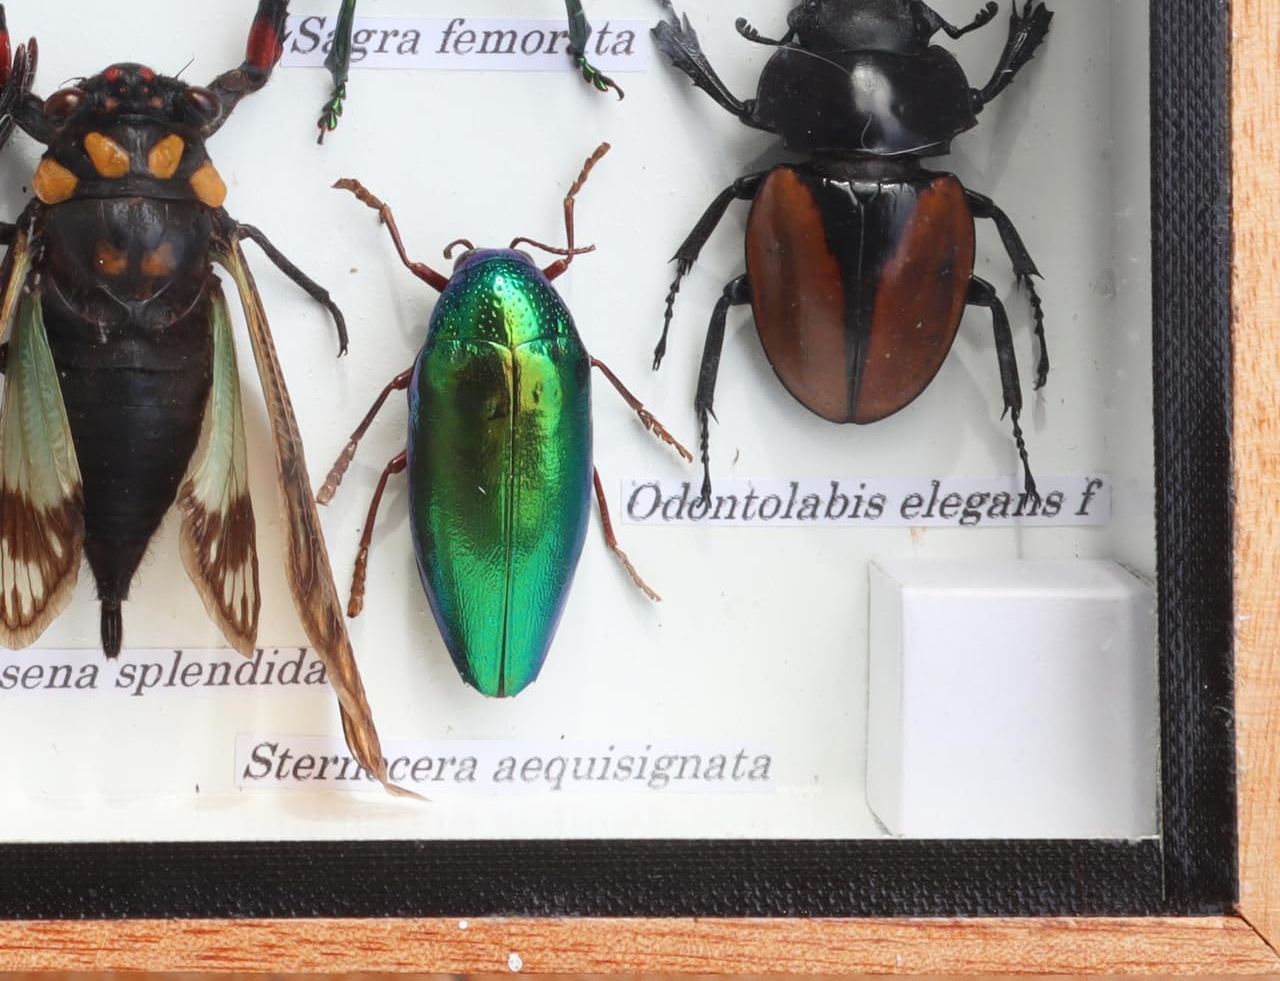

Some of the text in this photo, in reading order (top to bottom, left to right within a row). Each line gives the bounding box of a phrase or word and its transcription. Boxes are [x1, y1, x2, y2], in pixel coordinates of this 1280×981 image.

[434, 17, 636, 57] femorta
[626, 476, 1104, 527] Odontolabis elegans f
[114, 649, 329, 697] splendida
[492, 744, 772, 791] aequisignata
